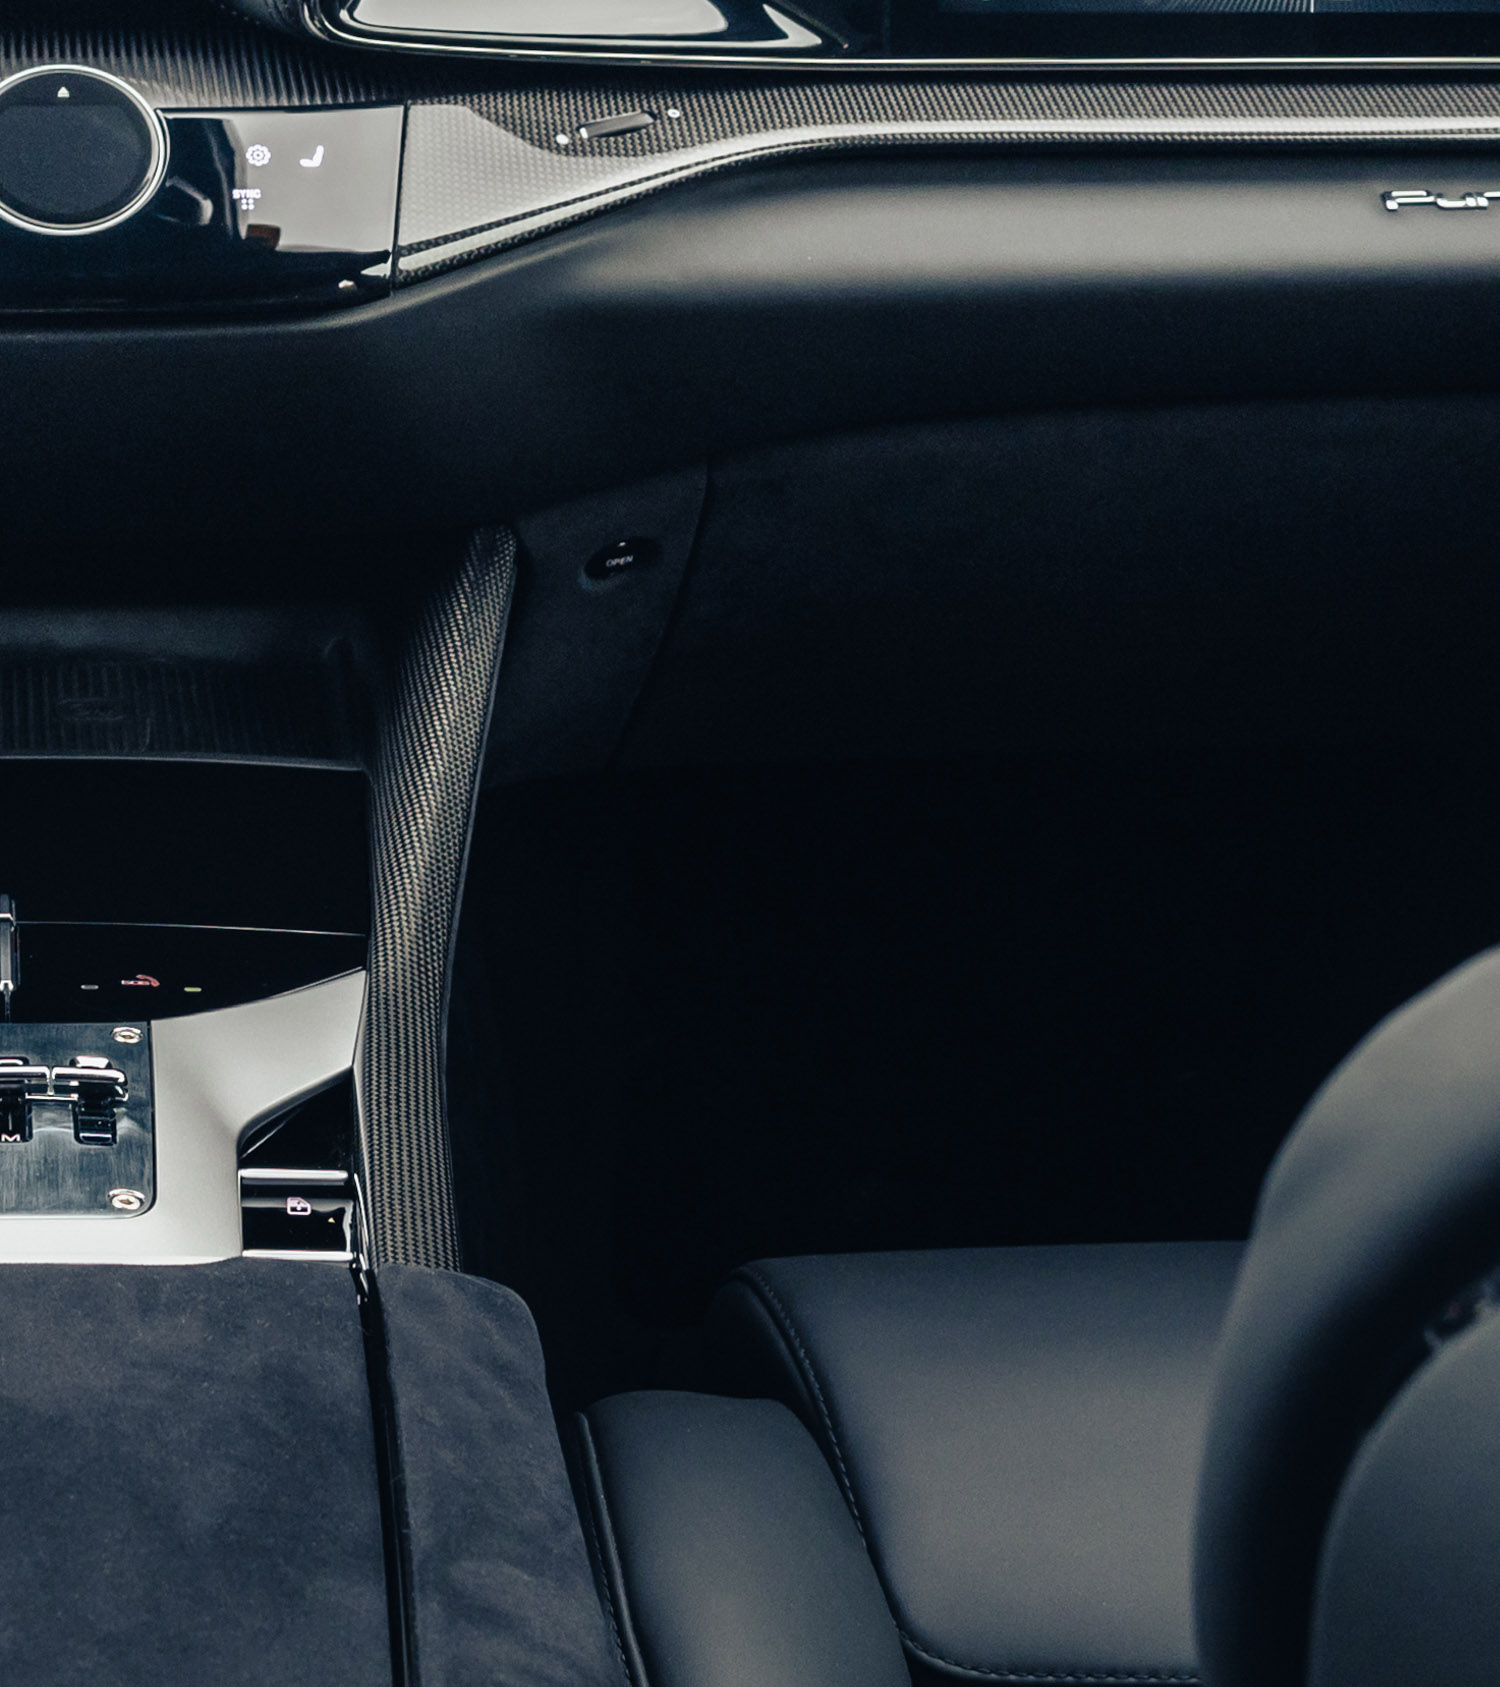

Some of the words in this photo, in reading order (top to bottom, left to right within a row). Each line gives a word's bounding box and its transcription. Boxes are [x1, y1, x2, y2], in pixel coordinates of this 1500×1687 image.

[232, 188, 262, 199] SYNC
[605, 555, 634, 567] OPEN
[1, 1133, 21, 1143] M
